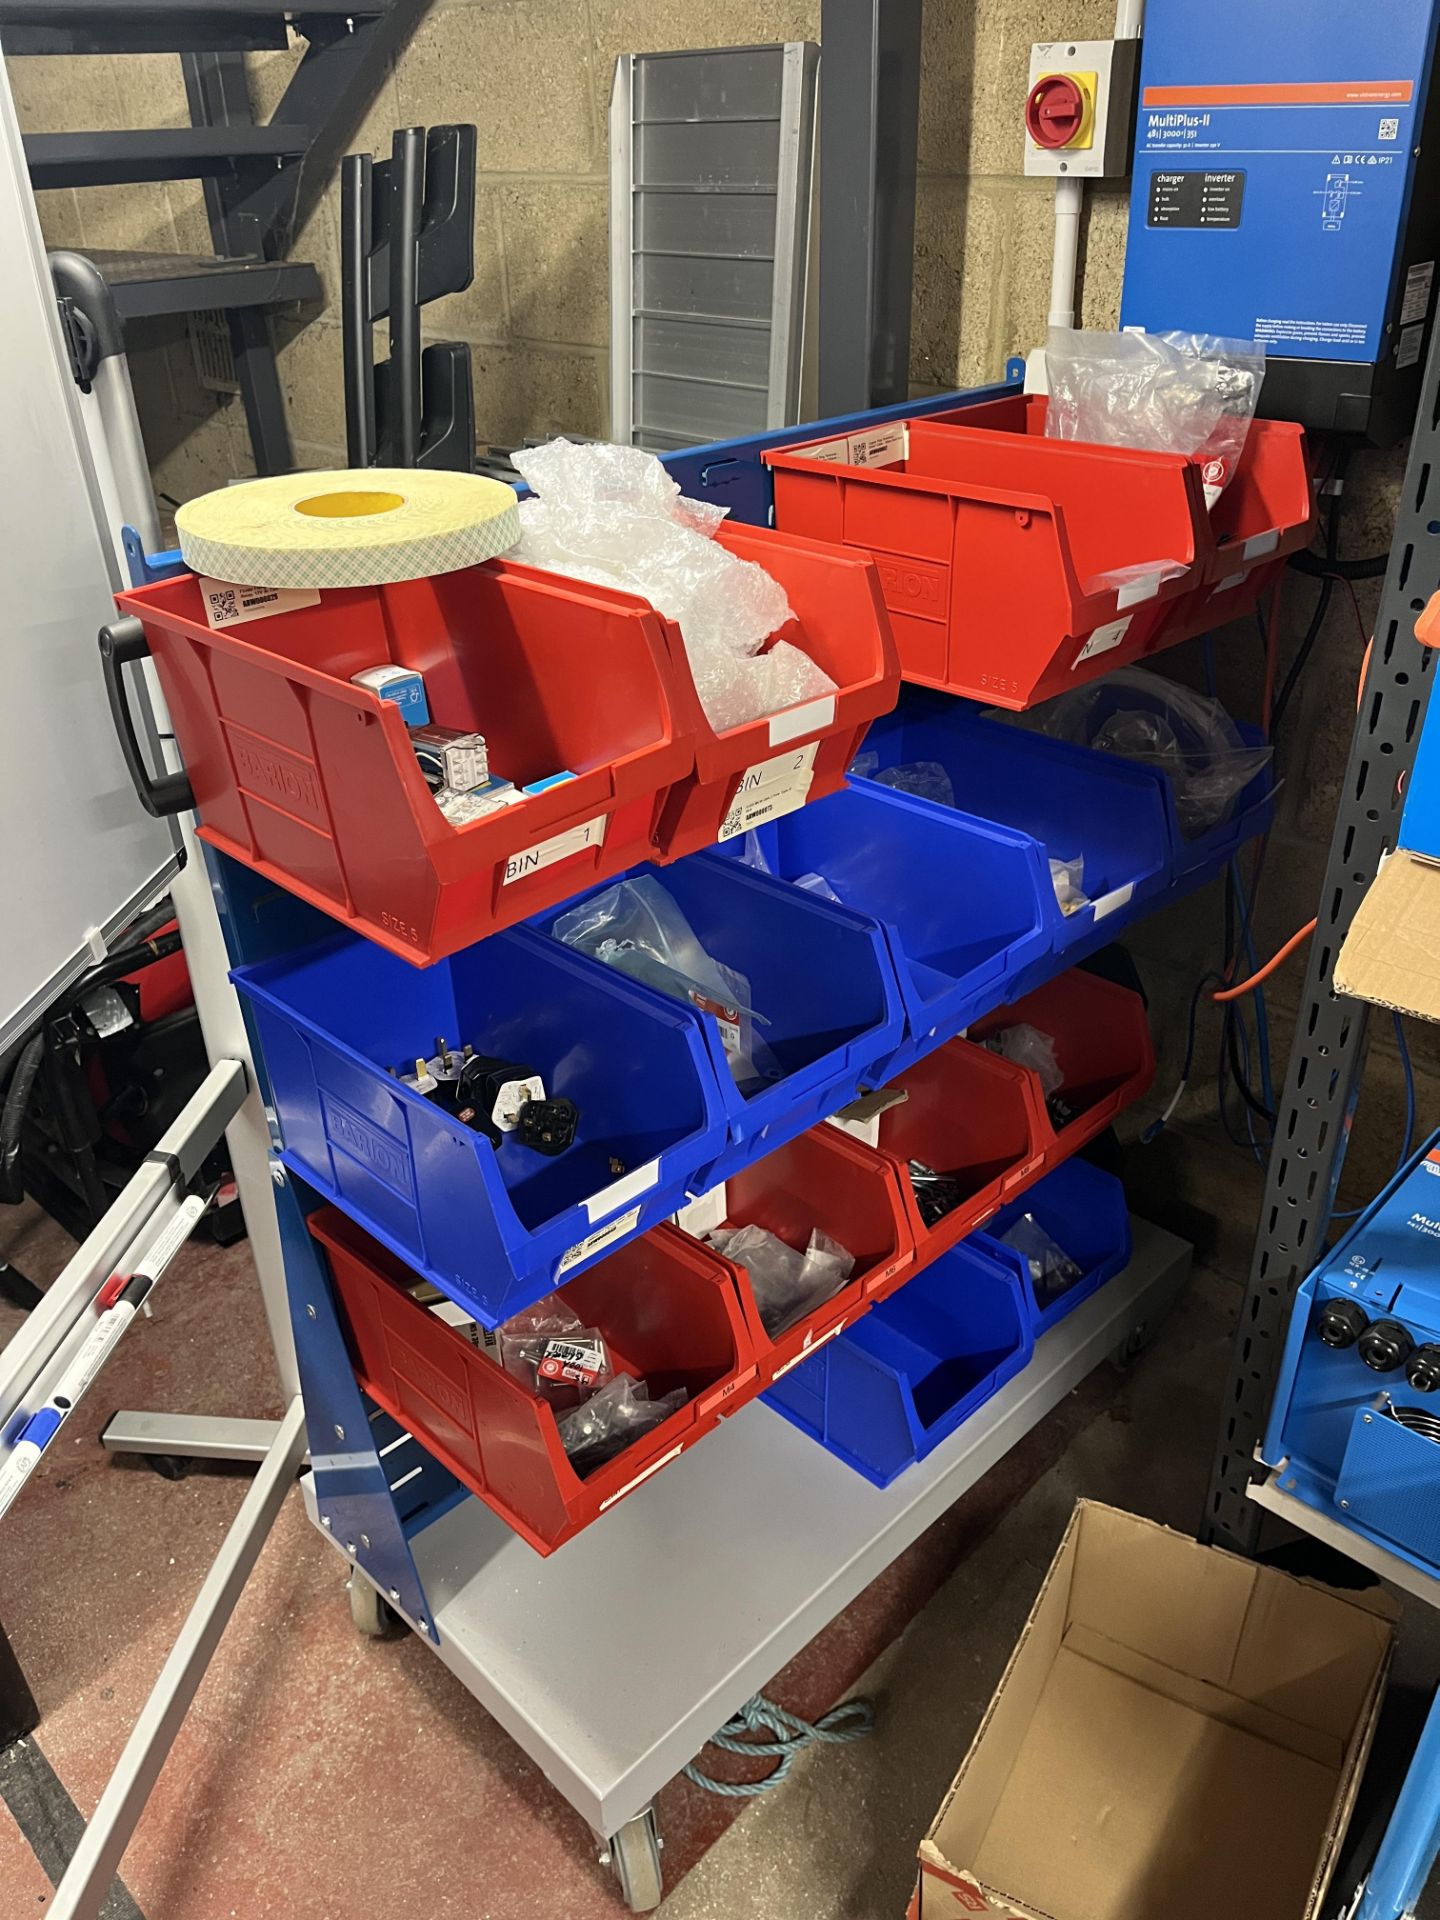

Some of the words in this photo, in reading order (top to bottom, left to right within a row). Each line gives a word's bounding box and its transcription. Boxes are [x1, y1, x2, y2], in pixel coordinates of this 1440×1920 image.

[1148, 113, 1210, 127] MultiPlus-II
[1378, 156, 1393, 164] IP21
[1157, 174, 1184, 185] charger
[1204, 173, 1236, 182] inverter
[980, 673, 1007, 691] SIZE
[1012, 681, 1019, 693] 5
[736, 771, 763, 795] BIN
[793, 754, 804, 770] 2
[506, 850, 539, 879] BIN
[583, 827, 590, 842] 1
[381, 911, 408, 937] SIZE
[411, 927, 419, 942] 5
[722, 1382, 736, 1398] M4
